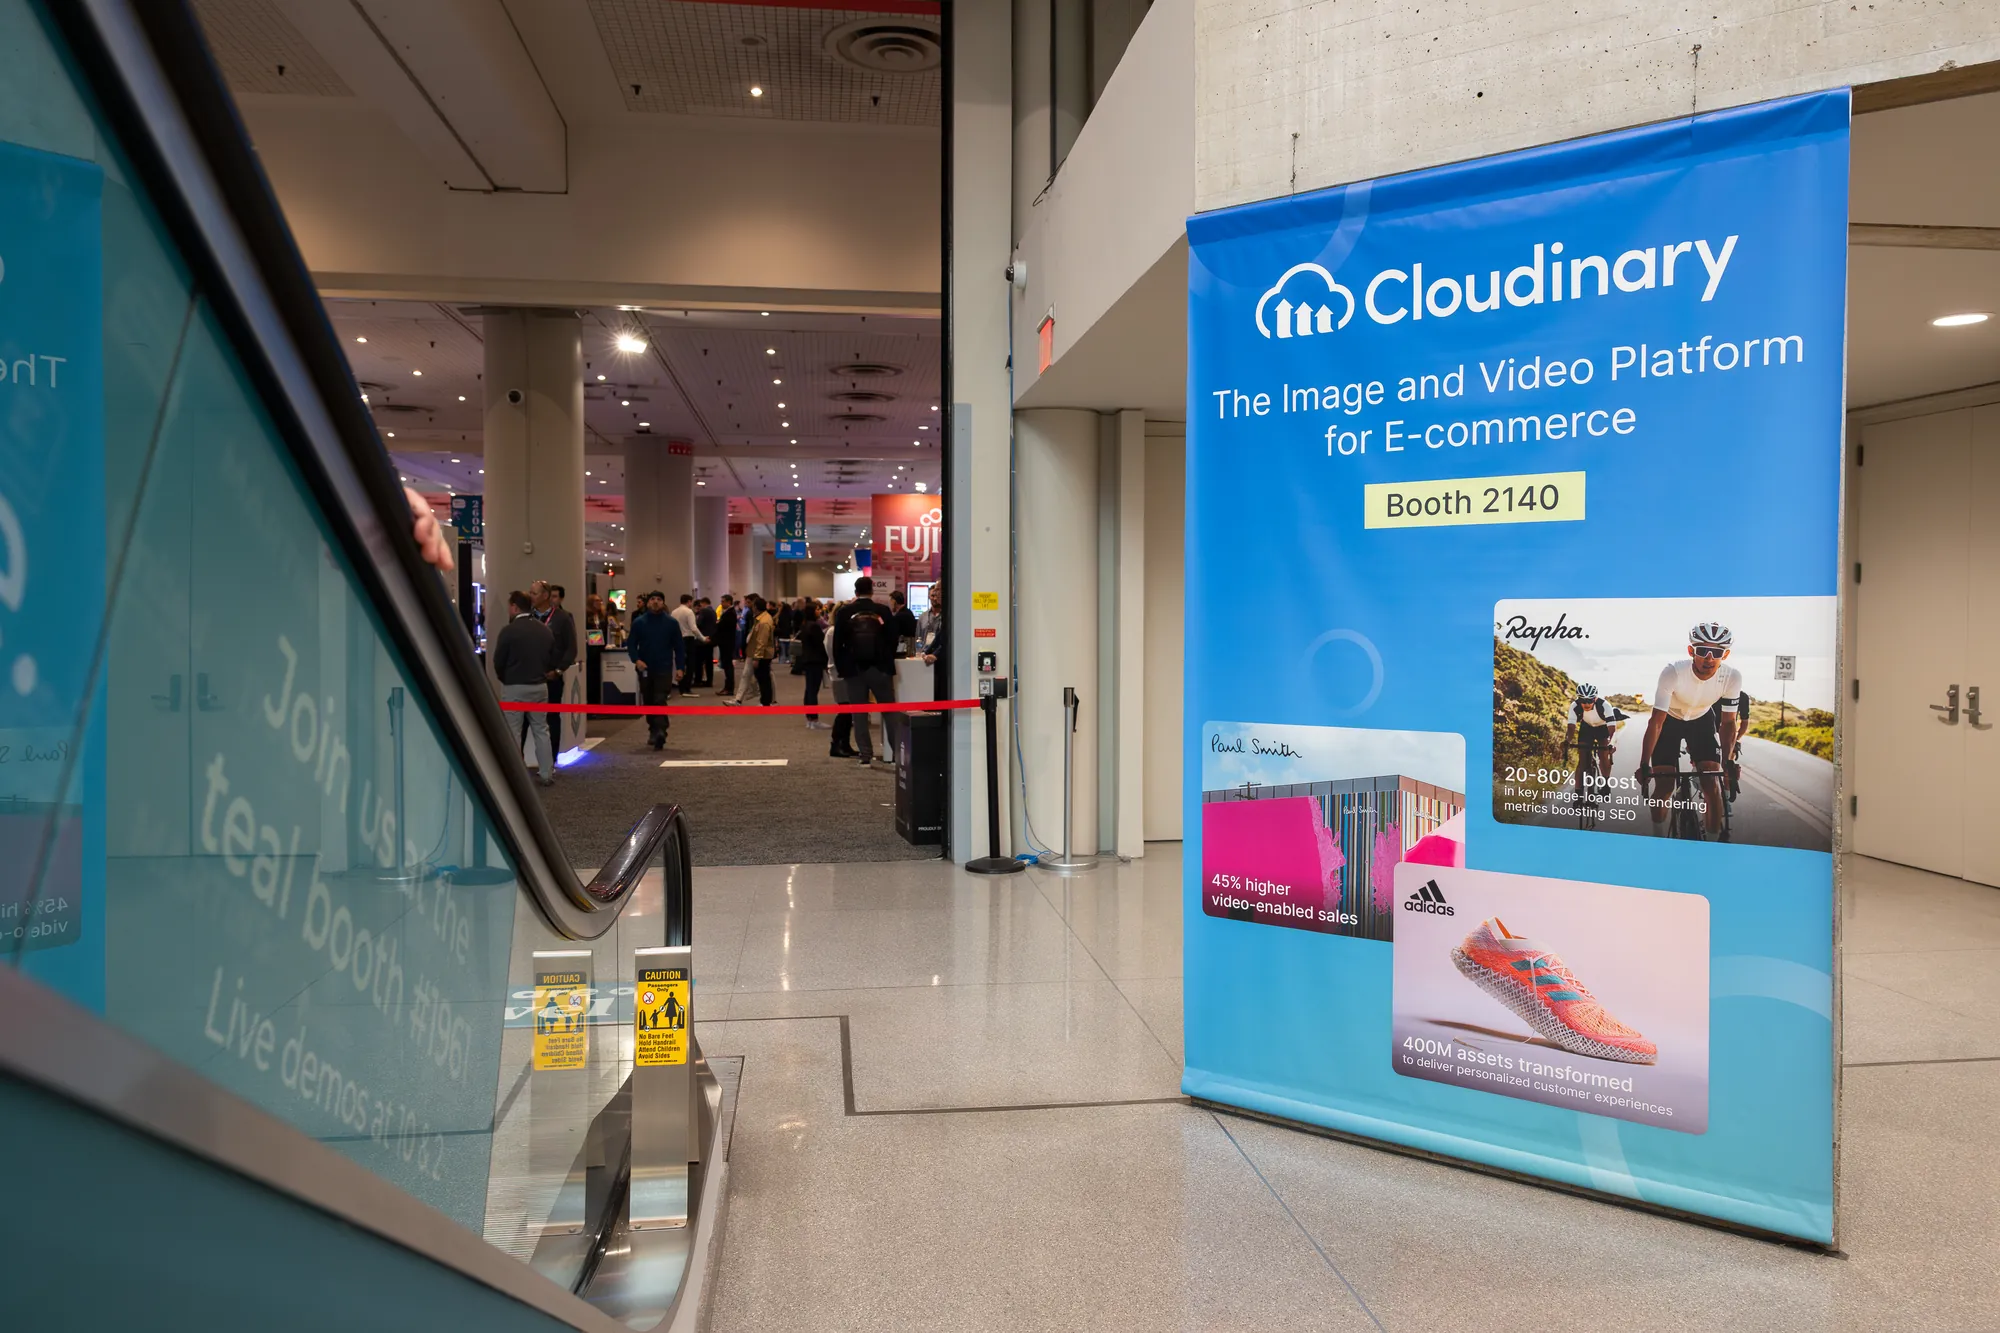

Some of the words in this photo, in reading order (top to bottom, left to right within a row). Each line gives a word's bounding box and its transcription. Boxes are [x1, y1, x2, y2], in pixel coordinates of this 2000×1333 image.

[1365, 235, 1739, 325] Cloudinary
[1212, 390, 1271, 419] The
[1282, 378, 1384, 415] Image
[1397, 365, 1465, 400] and
[1479, 349, 1594, 394] Video
[1610, 334, 1804, 381] Platform
[1324, 427, 1373, 456] for
[1385, 406, 1637, 453] E-commerce
[1386, 488, 1471, 518] Booth
[1482, 483, 1559, 514] 2140
[884, 525, 942, 562] FUJI
[1211, 733, 1246, 754] Paul
[1252, 738, 1303, 759] Smith
[1504, 766, 1577, 786] 20-80%
[1583, 771, 1637, 790] boost
[263, 632, 350, 815] Join
[360, 778, 397, 869] us
[433, 873, 470, 966] the
[1504, 785, 1515, 797] in
[1518, 786, 1539, 801] key
[1542, 788, 1612, 805] image-load
[1615, 793, 1639, 806] and
[1643, 795, 1707, 814] rendering
[1504, 801, 1548, 815] metrics
[1551, 803, 1605, 821] boosting
[1609, 808, 1636, 821] SEO
[1211, 873, 1241, 890] 45%
[1245, 878, 1291, 896] higher
[202, 752, 300, 919] teal
[303, 852, 404, 1023] booth
[410, 973, 472, 1080] #1967
[1211, 893, 1314, 920] video-enabled
[1318, 909, 1358, 925] sales
[1404, 899, 1455, 916] adidas
[645, 970, 681, 981] CAUTION
[204, 965, 275, 1072] Live
[281, 1026, 370, 1132] demos
[370, 1099, 394, 1150] at
[397, 1103, 417, 1163] 10
[1403, 1036, 1452, 1058] 400M
[1457, 1046, 1513, 1069] assets
[1519, 1058, 1633, 1092] transformed
[1402, 1054, 1414, 1065] to
[1416, 1055, 1453, 1072] deliver
[1457, 1064, 1530, 1088] personalized
[1533, 1079, 1590, 1100] customer
[1594, 1091, 1674, 1116] experiences
